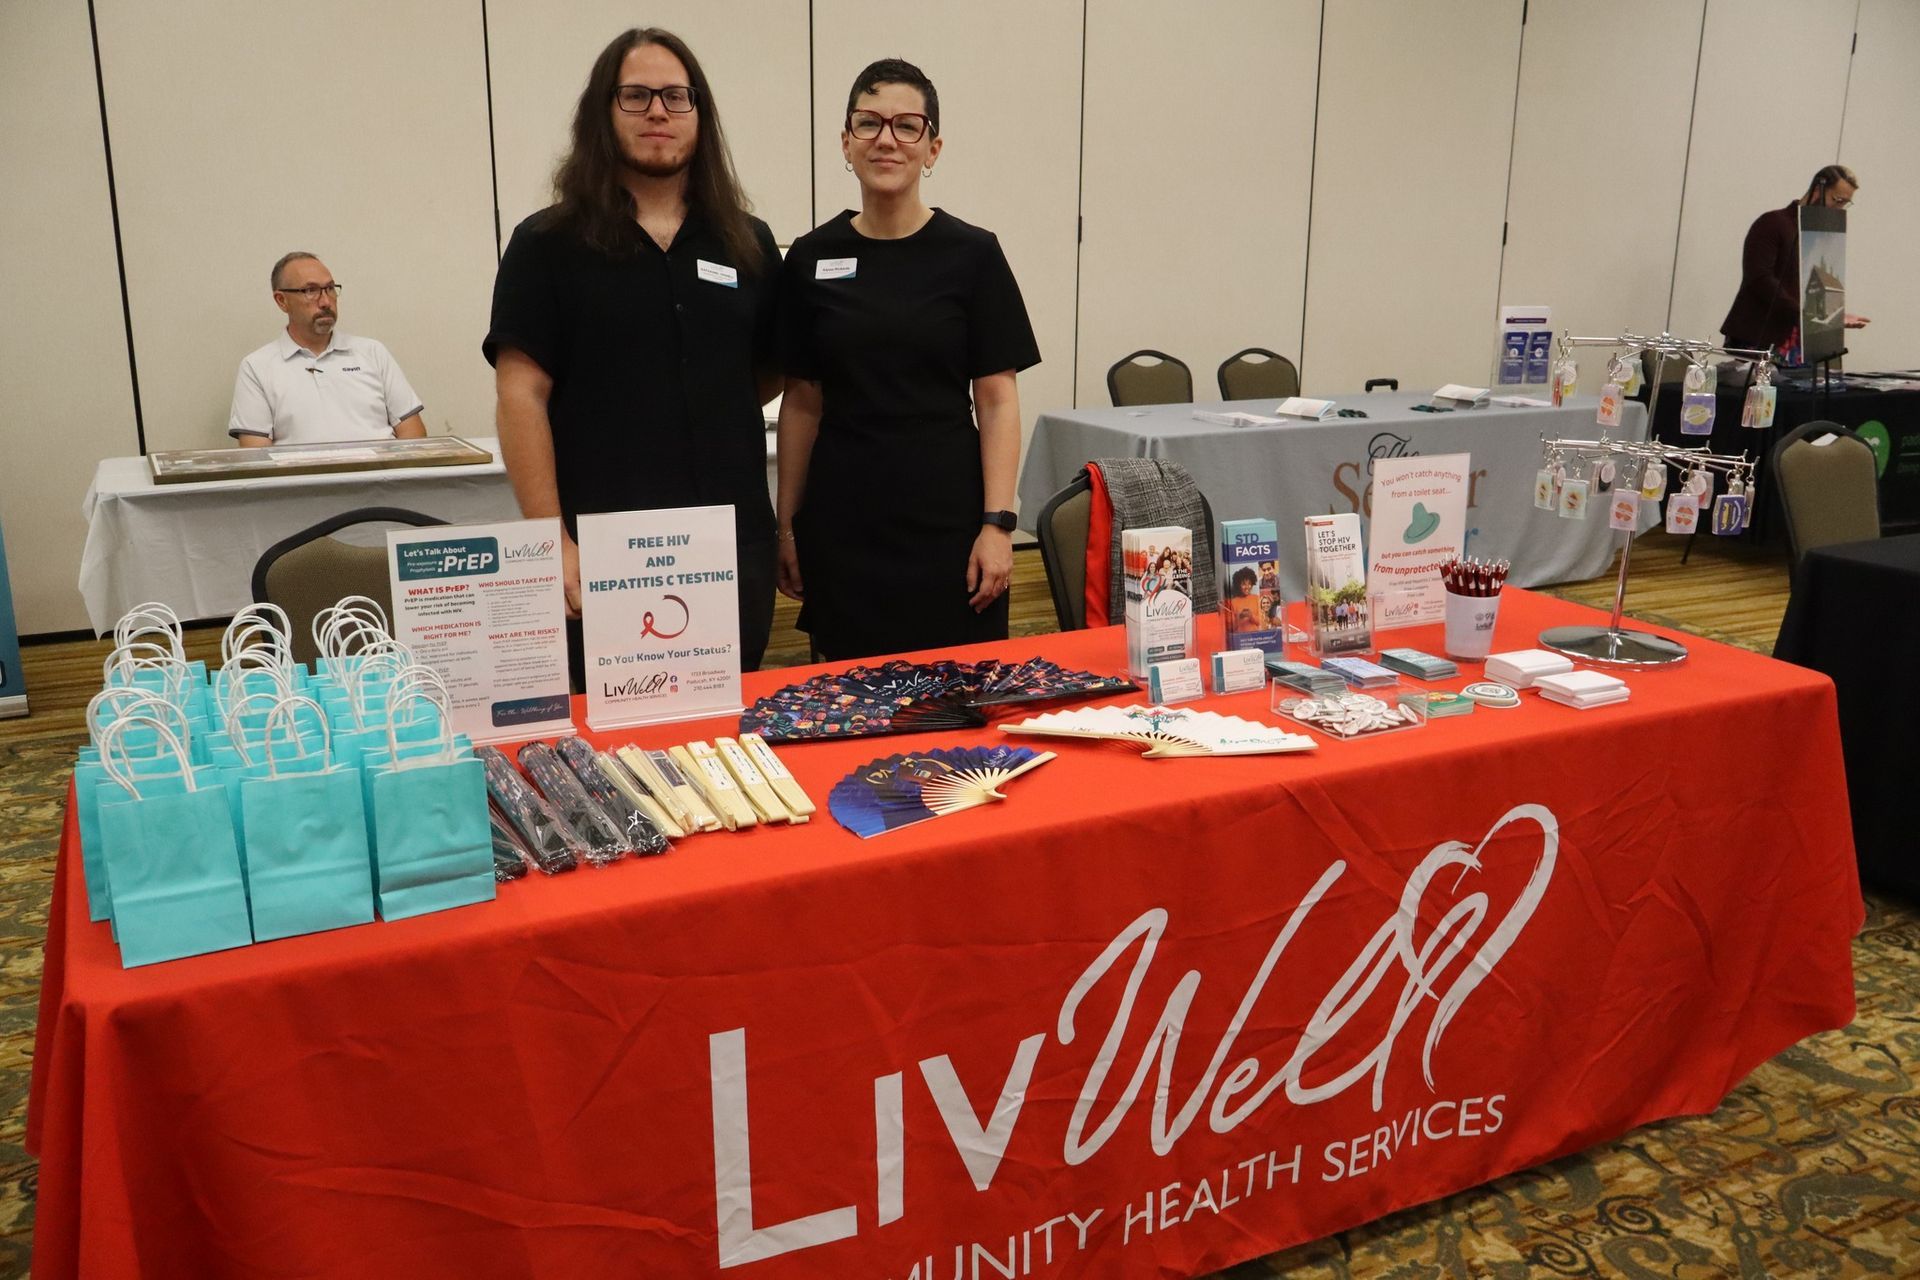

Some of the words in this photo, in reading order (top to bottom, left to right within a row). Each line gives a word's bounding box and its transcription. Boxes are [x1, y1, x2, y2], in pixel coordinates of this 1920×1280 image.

[1381, 479, 1395, 487] You
[1396, 472, 1413, 482] won't
[1415, 470, 1432, 478] catch
[1433, 470, 1461, 483] anything
[1391, 490, 1407, 498] from
[1414, 488, 1430, 496] toilet
[628, 536, 664, 550] FREE
[667, 534, 690, 547] HIV
[1235, 533, 1259, 545] STD
[1319, 537, 1336, 546] STOP
[1338, 536, 1350, 544] HIV
[403, 549, 424, 558] Let's
[425, 548, 441, 556] Talk
[442, 546, 467, 554] About
[1235, 544, 1271, 557] FACTS
[1320, 543, 1356, 553] TOGETHER
[1392, 551, 1401, 559] you
[1427, 546, 1455, 554] something
[646, 555, 675, 568] AND
[1373, 562, 1393, 574] from
[495, 579, 521, 587] SHOULD
[589, 576, 664, 593] HEPATITIS
[667, 575, 674, 586] C
[677, 570, 734, 585] TESTING
[408, 587, 434, 596] WHAT
[435, 586, 444, 594] IS
[446, 584, 470, 592] PrEP?
[434, 622, 474, 630] MEDICATION
[598, 656, 612, 667] Do
[614, 655, 634, 664] You
[636, 653, 665, 662] Know
[667, 649, 691, 659] Your
[693, 643, 732, 656] Status?
[709, 803, 1559, 1269] LivWell
[1123, 1144, 1302, 1246] HEALTH
[1321, 1094, 1506, 1183] SERVICES
